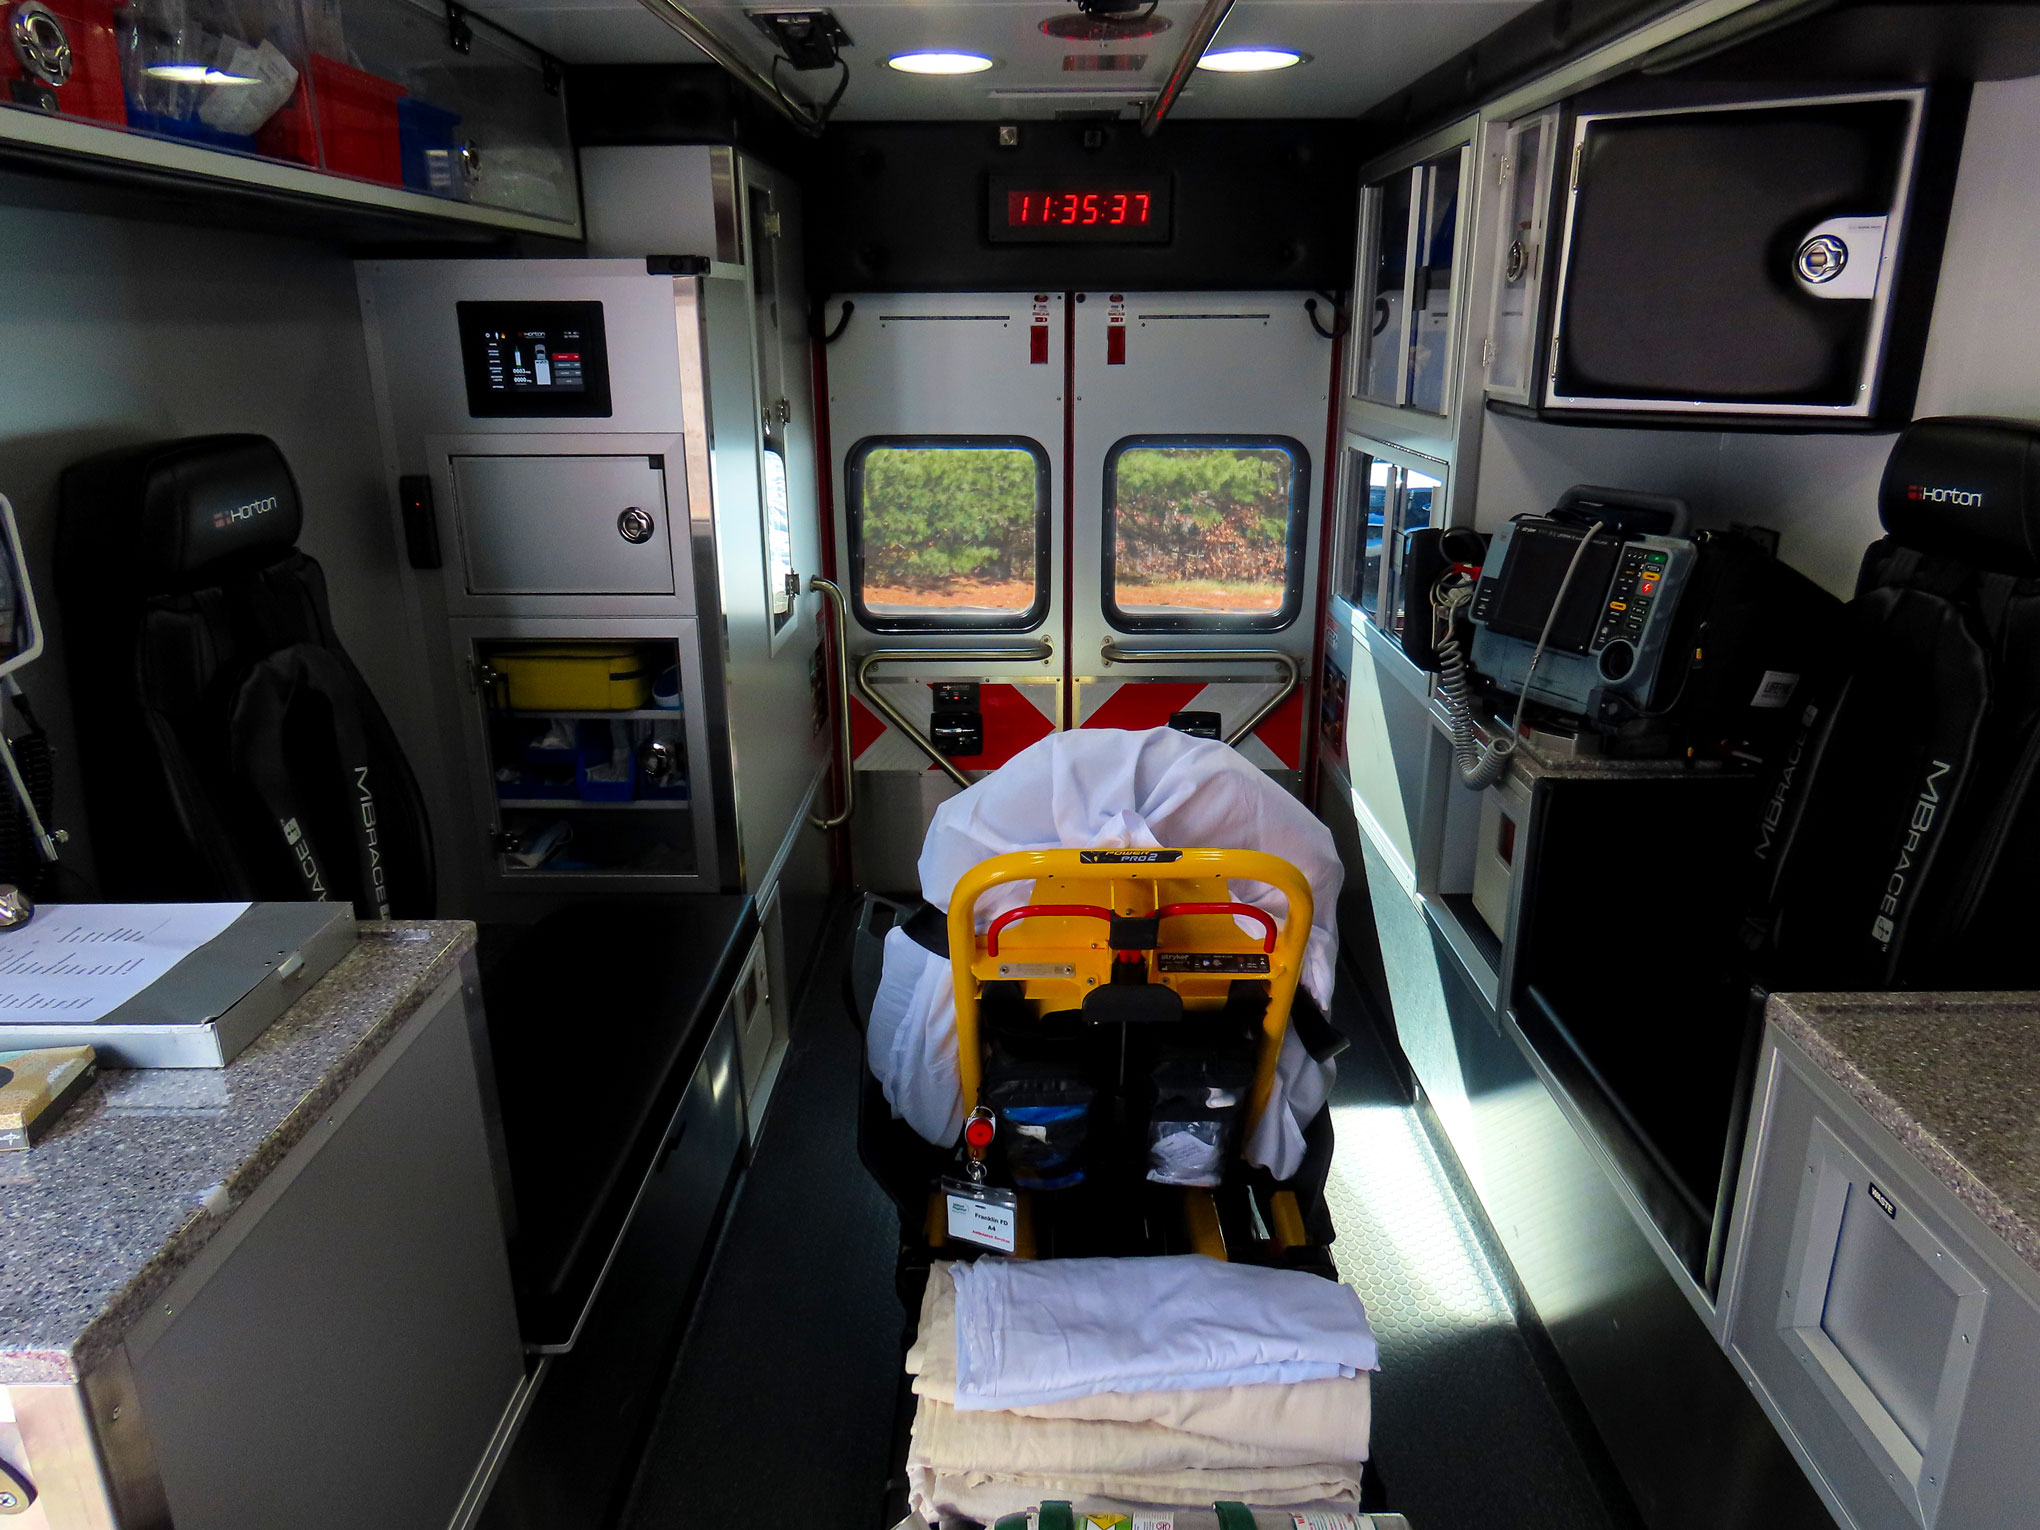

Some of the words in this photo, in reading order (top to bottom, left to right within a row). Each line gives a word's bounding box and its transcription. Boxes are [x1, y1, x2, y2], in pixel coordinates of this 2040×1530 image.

[1021, 194, 1149, 223] 11:35:37
[230, 496, 277, 523] Horton
[1922, 487, 1982, 508] Horton
[354, 766, 387, 903] MBRACE
[1880, 760, 1951, 916] MBRACE
[1871, 1186, 1894, 1215] WASTE
[974, 1212, 999, 1224] Franklin
